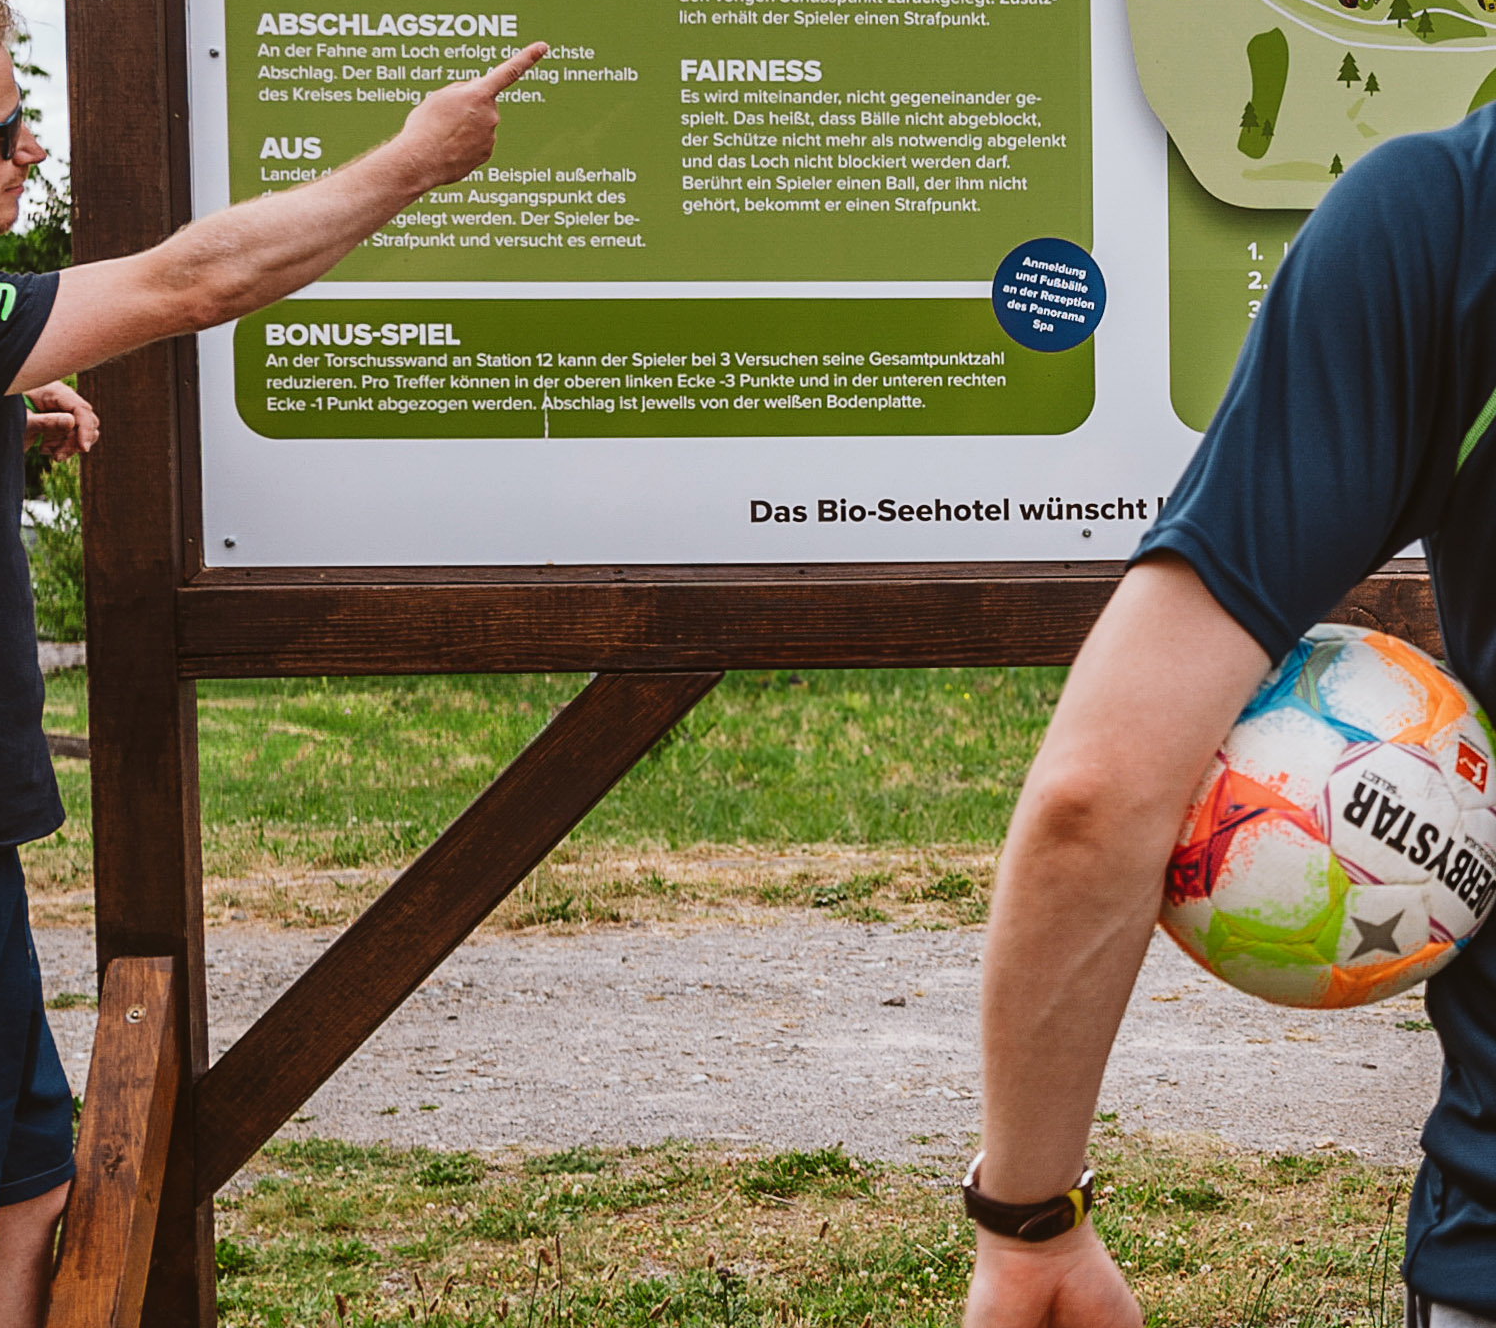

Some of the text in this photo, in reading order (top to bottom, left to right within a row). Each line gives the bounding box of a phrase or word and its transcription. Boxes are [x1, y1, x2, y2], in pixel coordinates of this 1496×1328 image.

[257, 13, 517, 37] ABSCHLAGSZONE
[681, 59, 822, 82] FAIRNESS
[681, 89, 1041, 108] Es wird miteinander, nicht gegeneinander ge-
[681, 110, 1041, 130] spielt. Das heißt, dass Bälle nicht abgeblockt,
[260, 136, 322, 160] AUS
[372, 232, 646, 250] Strafpunkt und versucht es erneut.
[1247, 242, 1264, 261] 1.
[1022, 256, 1087, 280] Anmeldung
[1015, 272, 1089, 294] und Fußbälle
[1248, 271, 1269, 290] 2.
[1002, 284, 1095, 311] an der Rezeption
[1006, 299, 1086, 324] des Panorama
[266, 323, 460, 346] BONUS-SPIEL
[1032, 318, 1054, 333] Spa
[266, 352, 1004, 370] An der Torschusswand an Station 12 kann der Spieler bei 3 Versuchen seine Gesamtpunktzahl
[267, 394, 925, 413] Ecke -1 Punkt abgezogen werden. Abschlag ist jeweils von der weißen Bodenplatte.
[751, 500, 807, 523] Das
[818, 498, 1009, 523] Bio-Seehotel
[1019, 496, 1147, 521] wünscht
